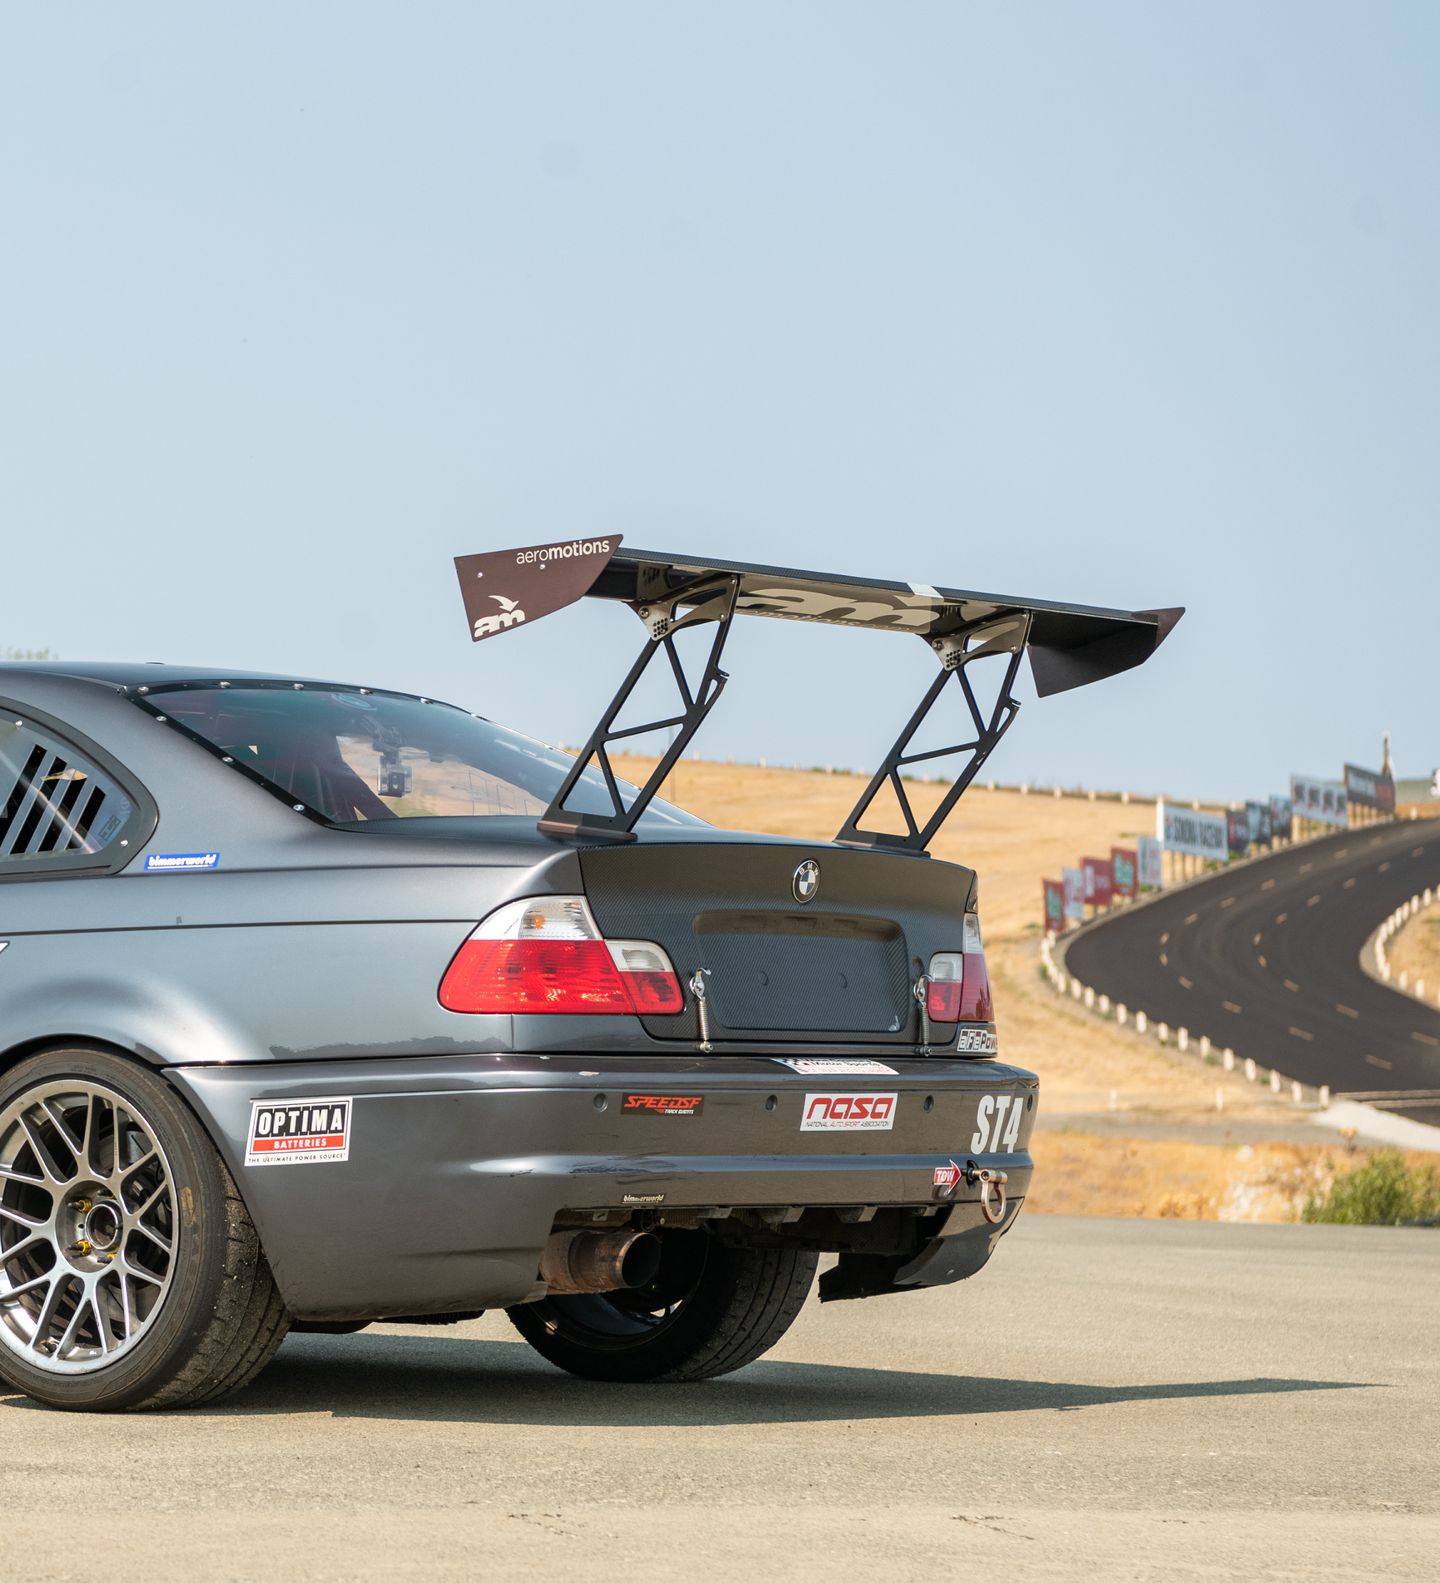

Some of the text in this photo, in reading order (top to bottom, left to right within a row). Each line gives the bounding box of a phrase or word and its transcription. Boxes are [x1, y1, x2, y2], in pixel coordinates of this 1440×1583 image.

[516, 540, 610, 565] aeromotions
[474, 609, 526, 638] am
[148, 854, 217, 866] bimmerworld
[623, 1095, 702, 1109] SPEEDSF
[806, 1097, 894, 1120] nasa
[258, 1108, 343, 1135] OPTIMA
[970, 1095, 1024, 1155] ST4
[274, 1138, 327, 1149] BATTERIES
[936, 1168, 956, 1183] TOW
